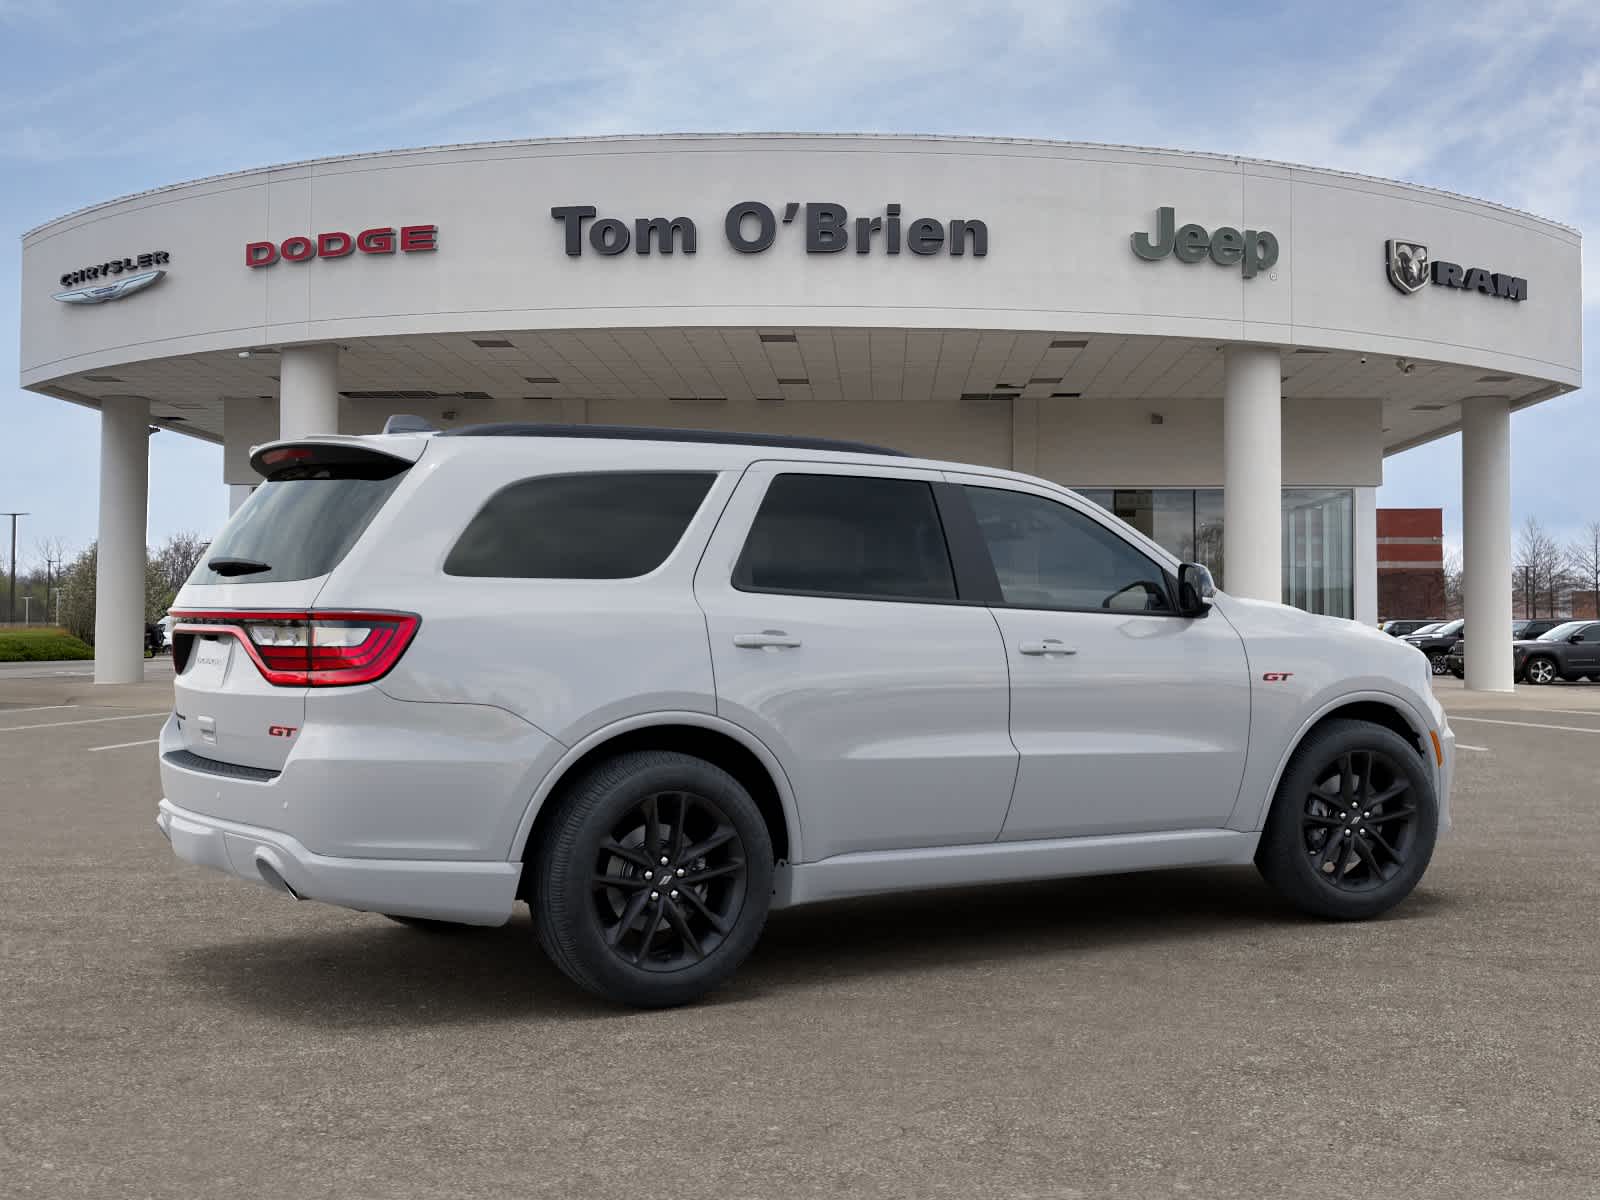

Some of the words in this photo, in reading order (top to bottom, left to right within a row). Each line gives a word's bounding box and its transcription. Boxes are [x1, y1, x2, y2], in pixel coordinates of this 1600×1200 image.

[245, 225, 438, 269] DODGE
[551, 205, 696, 256] Tom
[725, 201, 988, 256] O'Brien
[1131, 206, 1279, 279] Jeep
[61, 250, 170, 287] CHRYSLER
[1431, 260, 1528, 301] RAM
[1262, 672, 1294, 682] GT
[268, 726, 297, 737] GT
